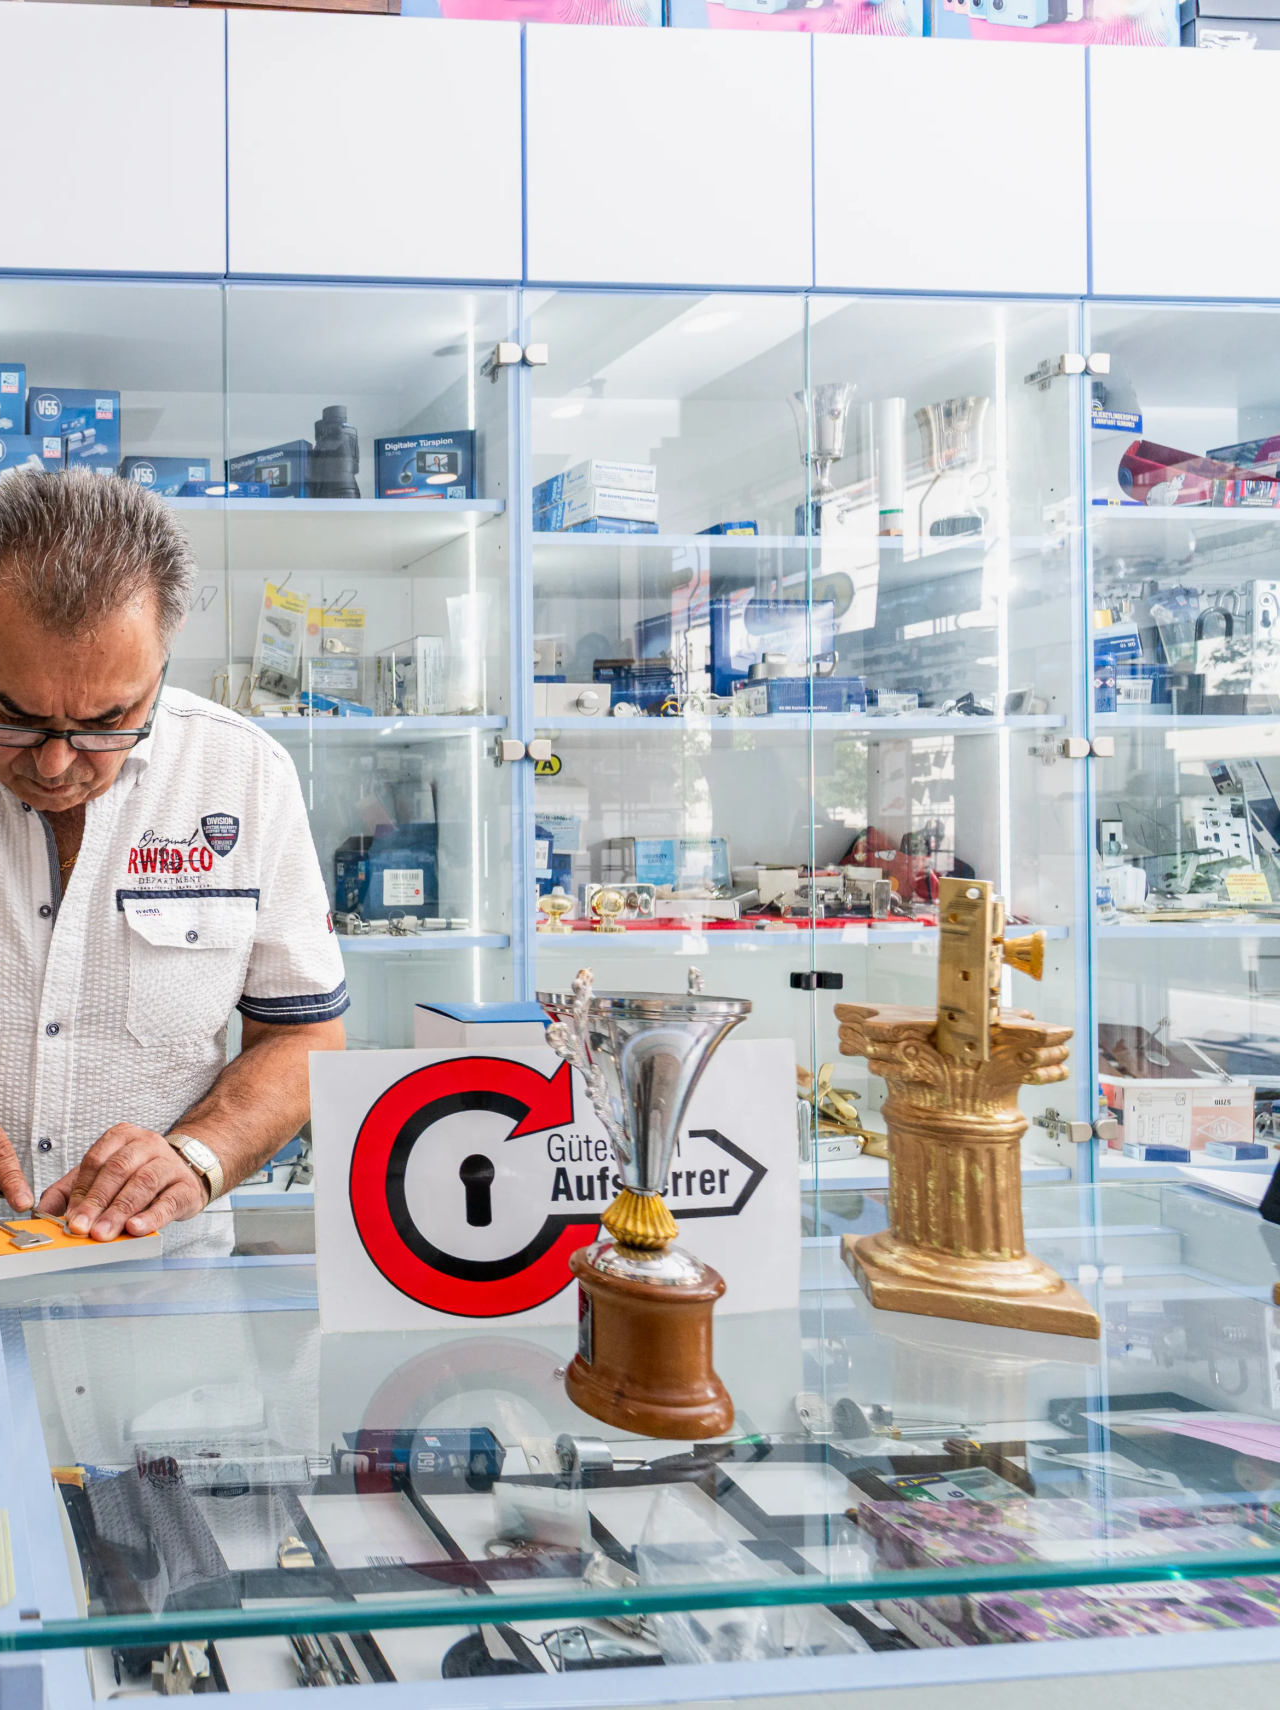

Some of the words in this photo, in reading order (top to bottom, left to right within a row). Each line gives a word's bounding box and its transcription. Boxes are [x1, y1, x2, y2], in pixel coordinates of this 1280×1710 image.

[37, 400, 58, 416] V55
[384, 441, 417, 451] Digitaler
[419, 437, 453, 448] Türspion
[230, 458, 256, 470] Digitaler
[257, 450, 284, 463] Türspion
[133, 467, 153, 484] V55
[206, 816, 234, 825] DIVISION
[137, 828, 200, 850] Original
[127, 846, 214, 874] RWRD.CO
[138, 875, 202, 885] DEPARTMENT
[551, 1166, 730, 1202] Aufsrrer
[417, 1452, 435, 1474] V50
